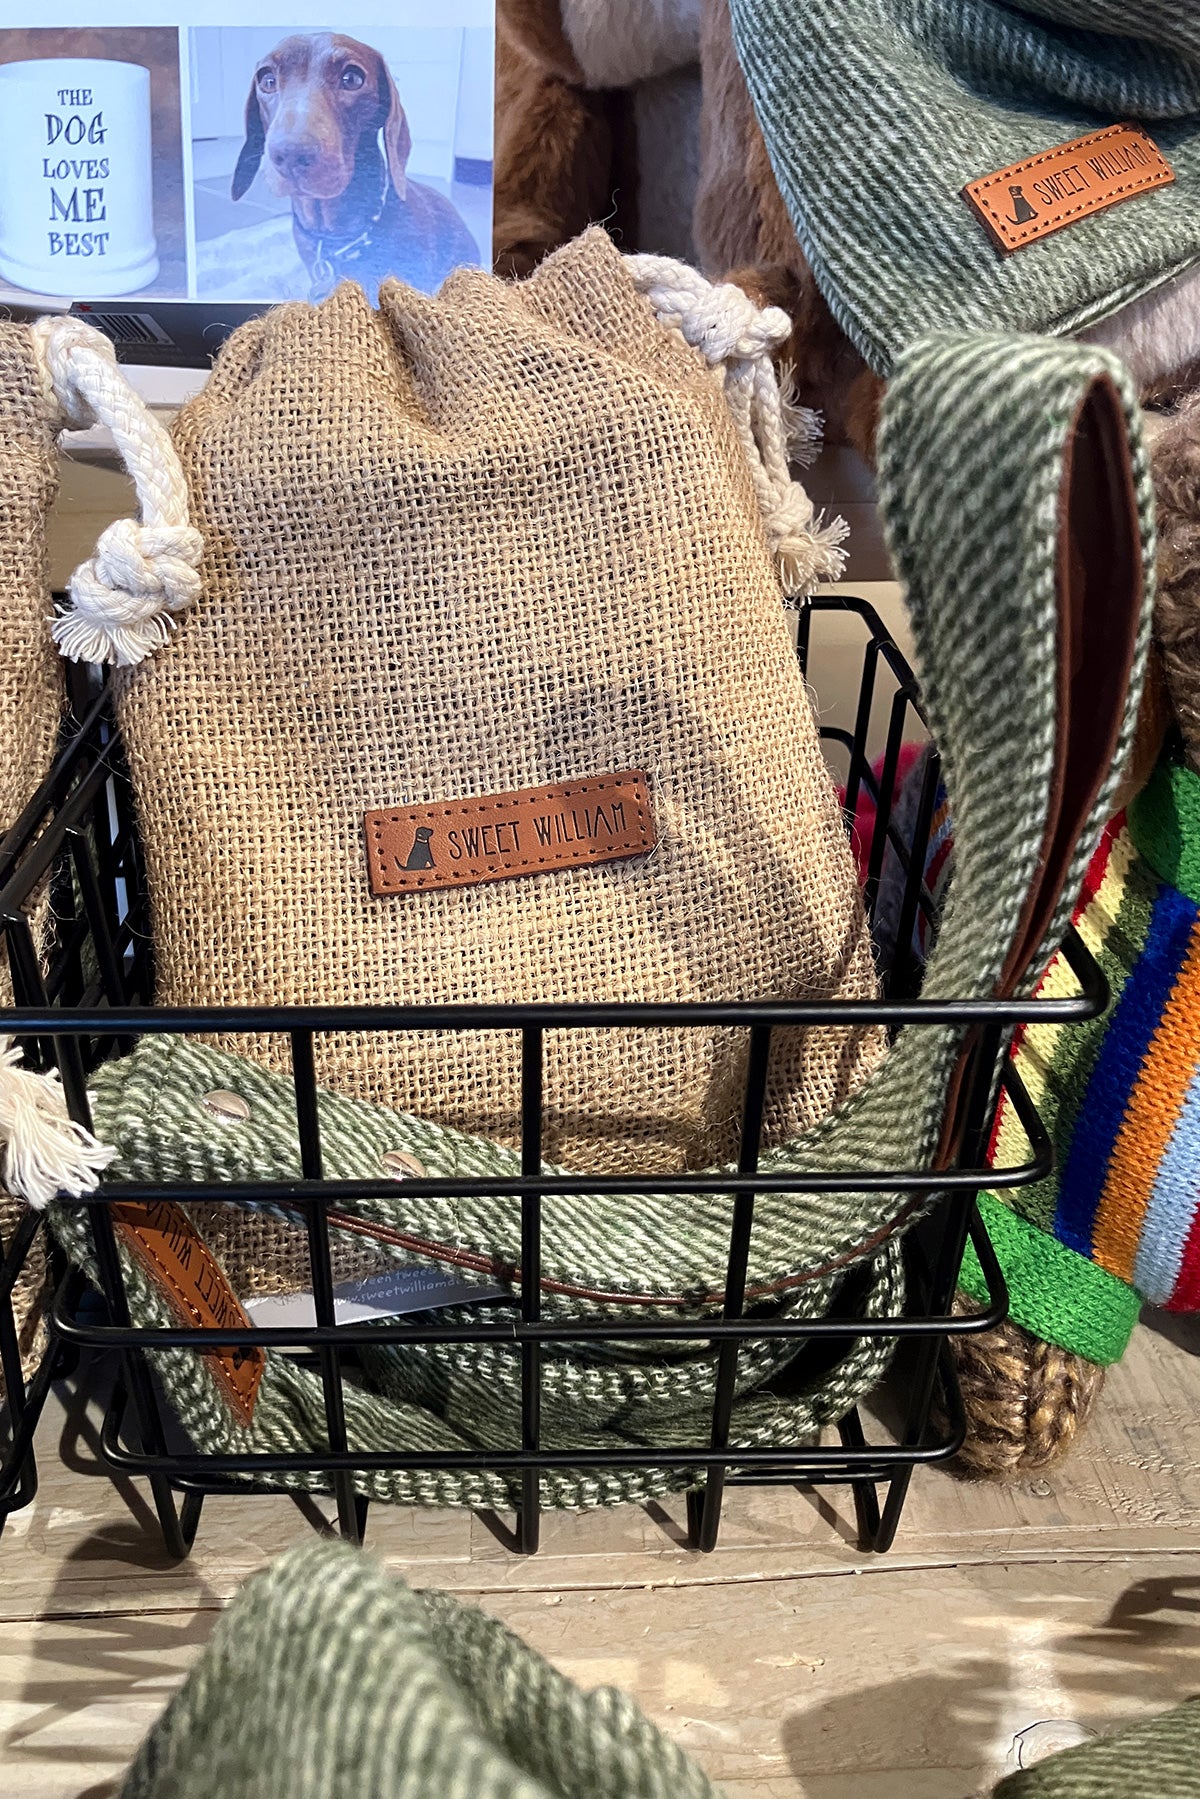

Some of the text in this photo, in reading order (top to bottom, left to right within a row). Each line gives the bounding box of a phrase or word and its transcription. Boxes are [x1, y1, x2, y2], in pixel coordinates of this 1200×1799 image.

[57, 88, 93, 106] THE
[44, 111, 108, 145] DOG
[42, 157, 110, 180] LOVES
[1033, 142, 1152, 205] SWEET WILLIAM
[49, 186, 106, 222] ME
[47, 231, 110, 257] BEST
[448, 801, 627, 860] SWEET WILLIAM
